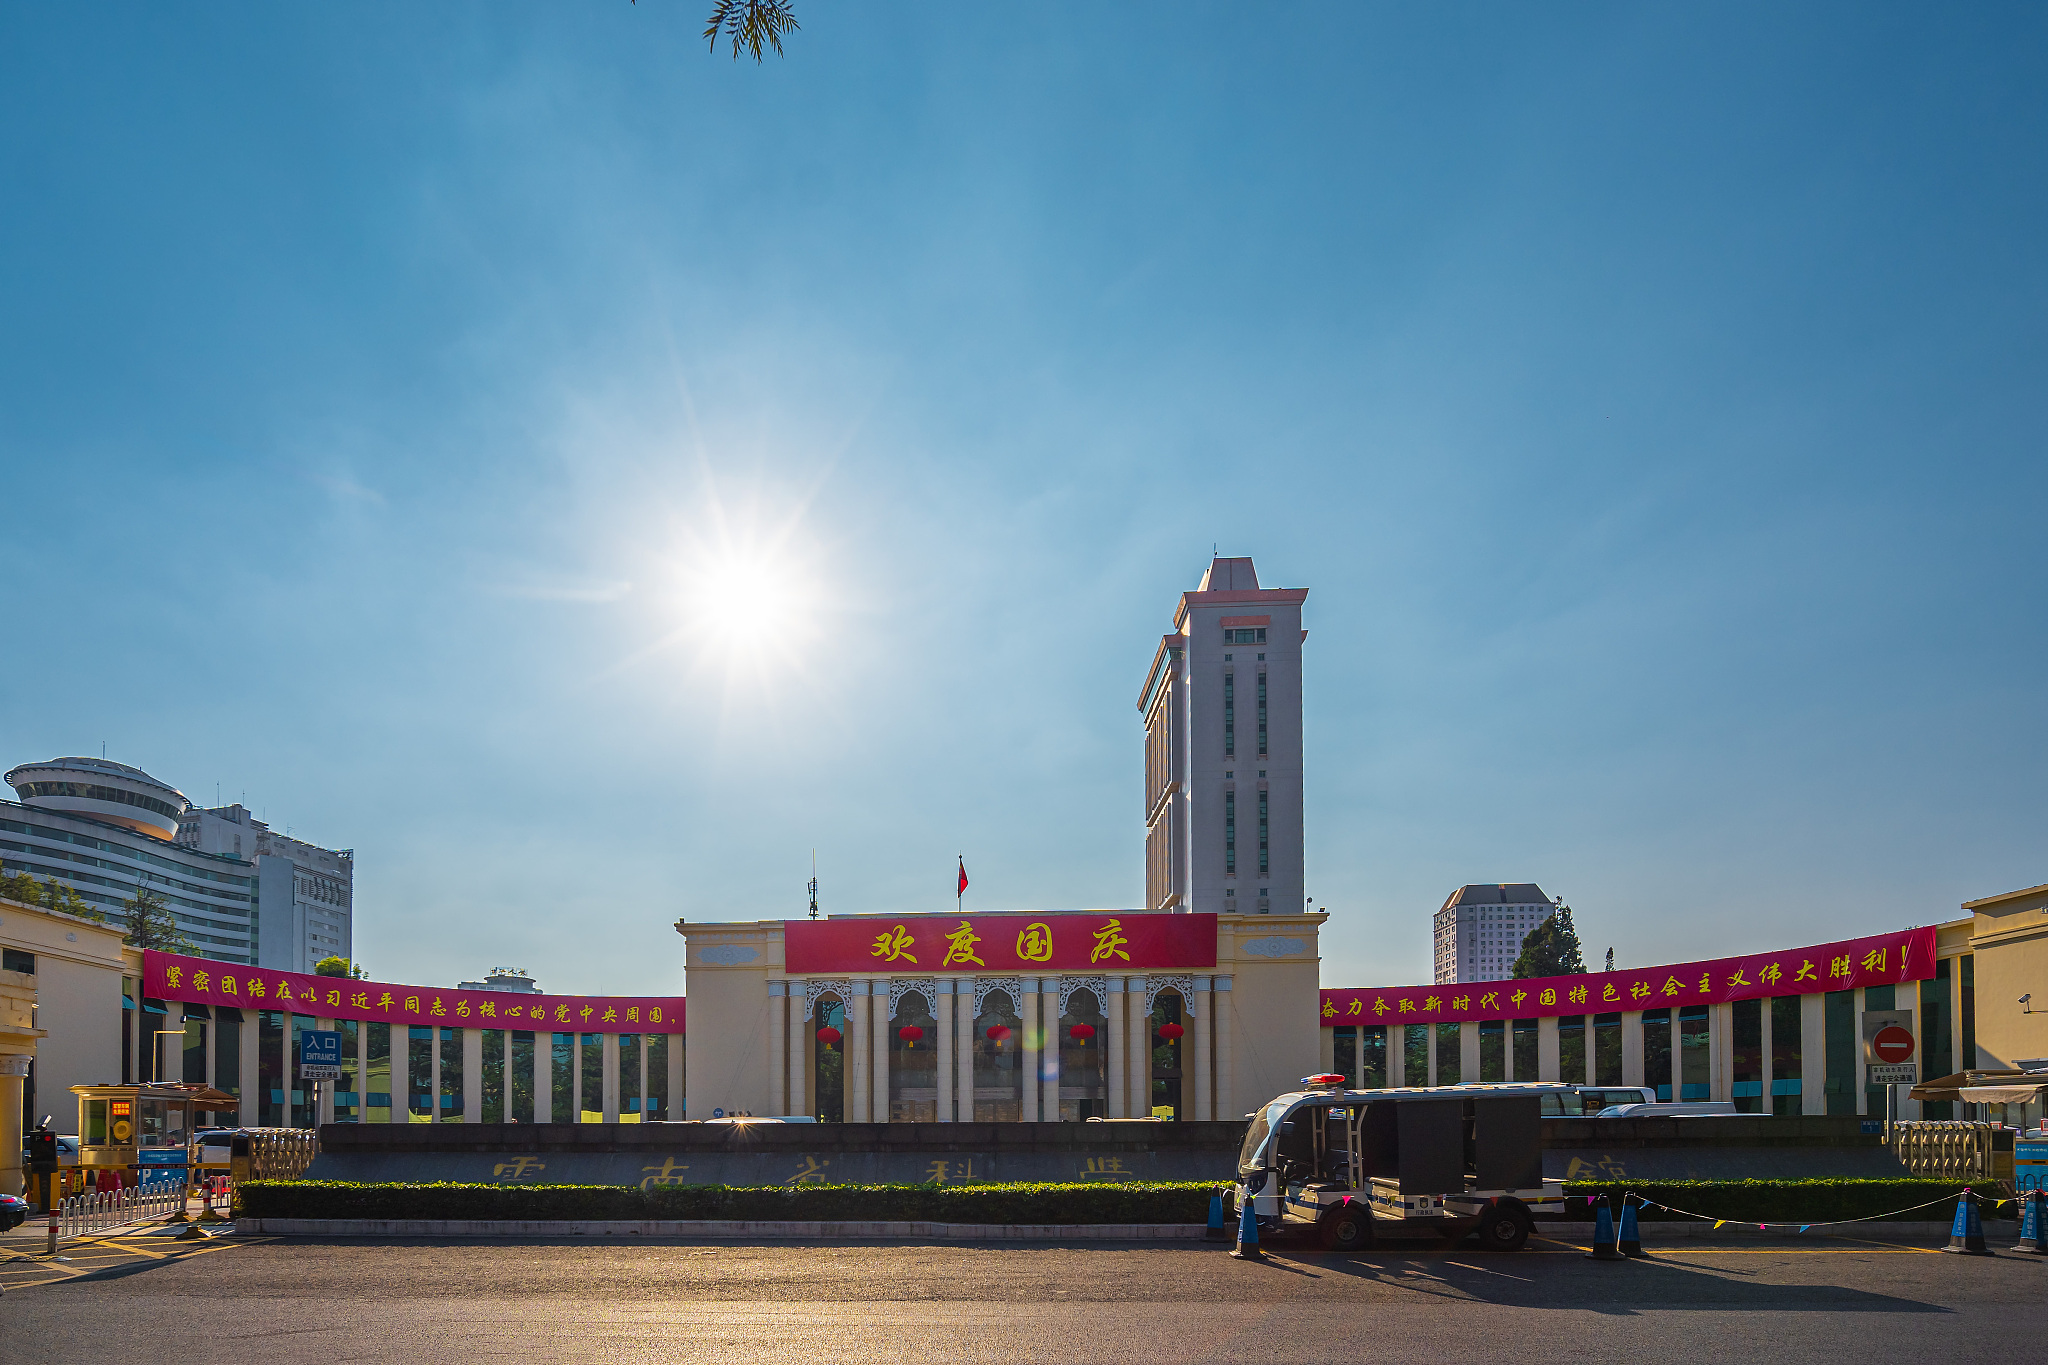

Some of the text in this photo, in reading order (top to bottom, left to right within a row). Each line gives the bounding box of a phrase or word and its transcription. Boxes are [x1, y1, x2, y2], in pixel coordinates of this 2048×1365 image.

[870, 918, 1130, 967] 欢度国庆
[306, 1035, 336, 1050] 入口
[306, 1052, 336, 1061] ENTRANCE
